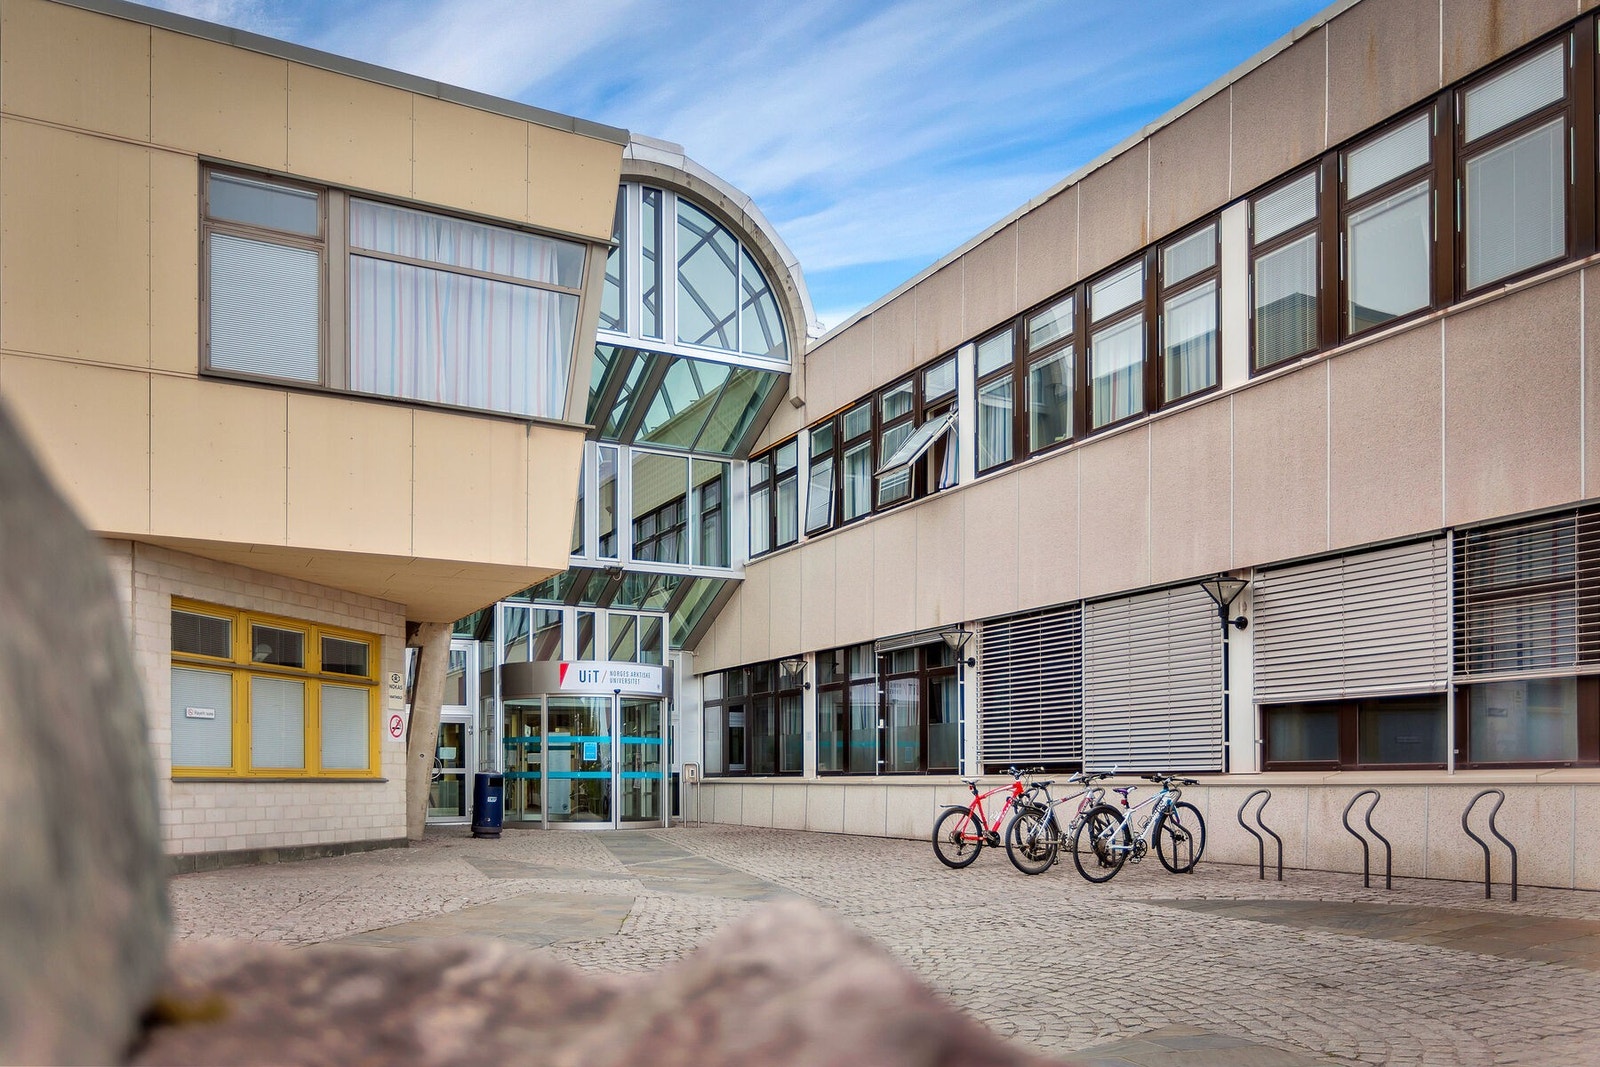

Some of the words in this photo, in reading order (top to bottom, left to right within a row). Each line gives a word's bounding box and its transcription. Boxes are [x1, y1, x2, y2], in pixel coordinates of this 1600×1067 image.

[579, 670, 600, 683] UiT
[610, 670, 629, 678] NORGES
[610, 677, 640, 685] UNIVERSITET
